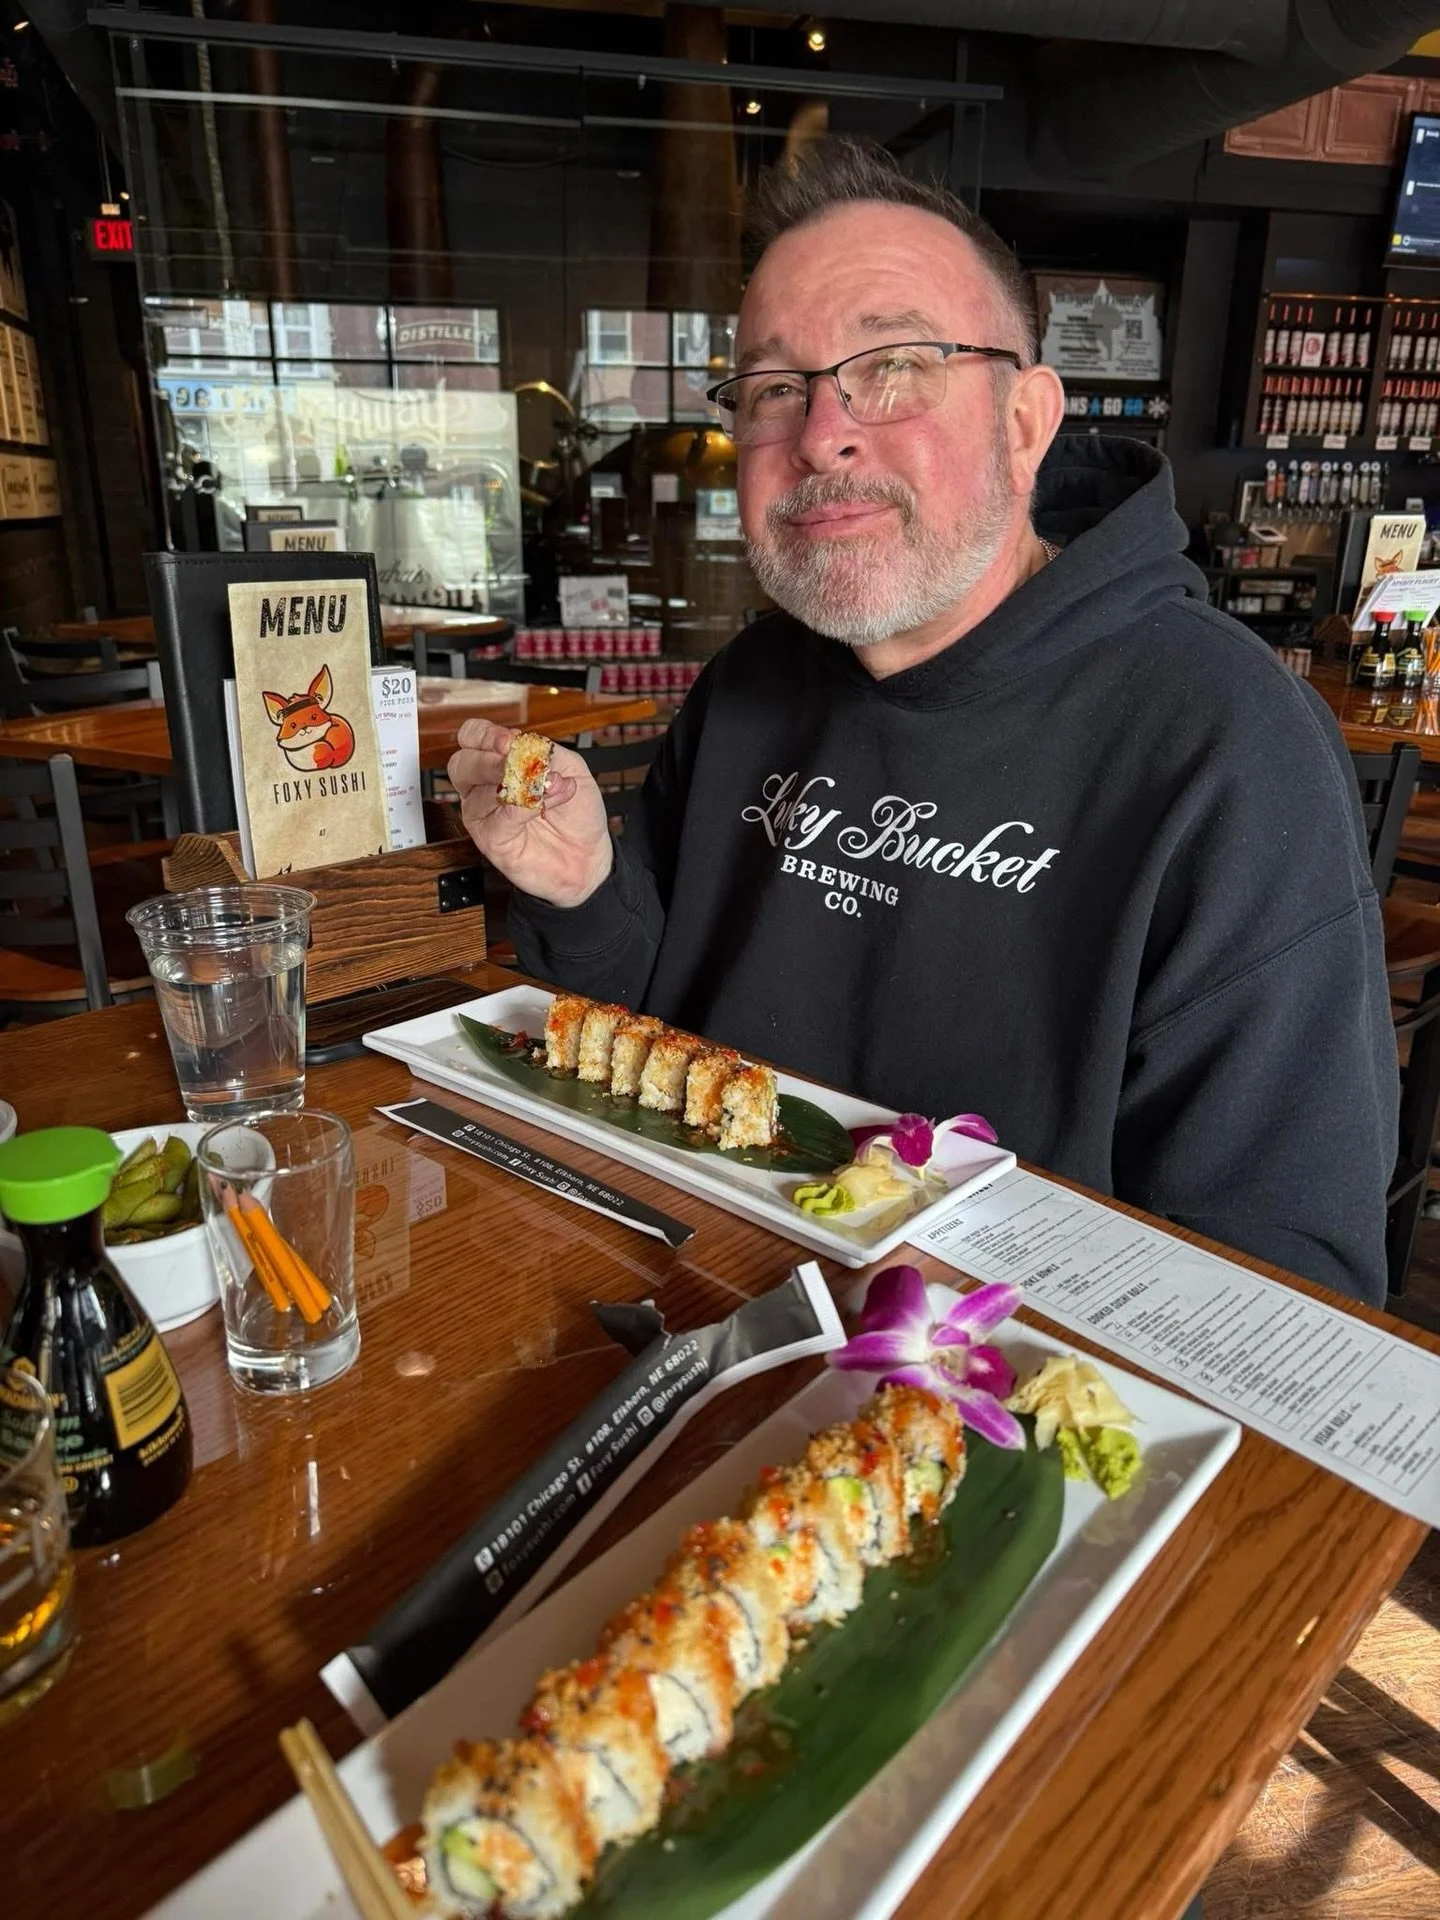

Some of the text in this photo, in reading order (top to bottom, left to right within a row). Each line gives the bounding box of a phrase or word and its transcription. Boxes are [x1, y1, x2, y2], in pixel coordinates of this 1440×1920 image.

[94, 220, 134, 250] EXIT
[1064, 396, 1088, 416] ANS
[1103, 397, 1123, 416] GO
[284, 536, 328, 552] MENU
[1380, 523, 1418, 540] MENU
[259, 594, 348, 639] MENU
[382, 676, 412, 699] $20
[273, 779, 312, 805] FOXY
[319, 771, 367, 797] SUSHI
[837, 795, 1061, 894] Bucket
[780, 853, 900, 908] BREWING
[823, 890, 863, 919] CO.
[473, 1128, 495, 1142] 18101
[494, 1138, 521, 1155] Chicago
[520, 1151, 532, 1162] St.
[585, 1183, 600, 1194] NE
[598, 1189, 625, 1208] 68022
[519, 1161, 537, 1176] Foxy
[535, 1171, 558, 1185] Sushi
[927, 1218, 965, 1240] APPETIZERS
[1087, 1304, 1115, 1325] COOKED
[1127, 1282, 1150, 1297] ROLLS
[611, 1423, 639, 1456] Sushi
[651, 1358, 711, 1414] @foxysushi
[490, 1515, 529, 1554] 18101
[526, 1472, 570, 1517] Chicago
[566, 1455, 585, 1476] St.
[611, 1385, 652, 1427] Elkhorn,
[648, 1366, 665, 1386] NE
[664, 1339, 699, 1372] 68022
